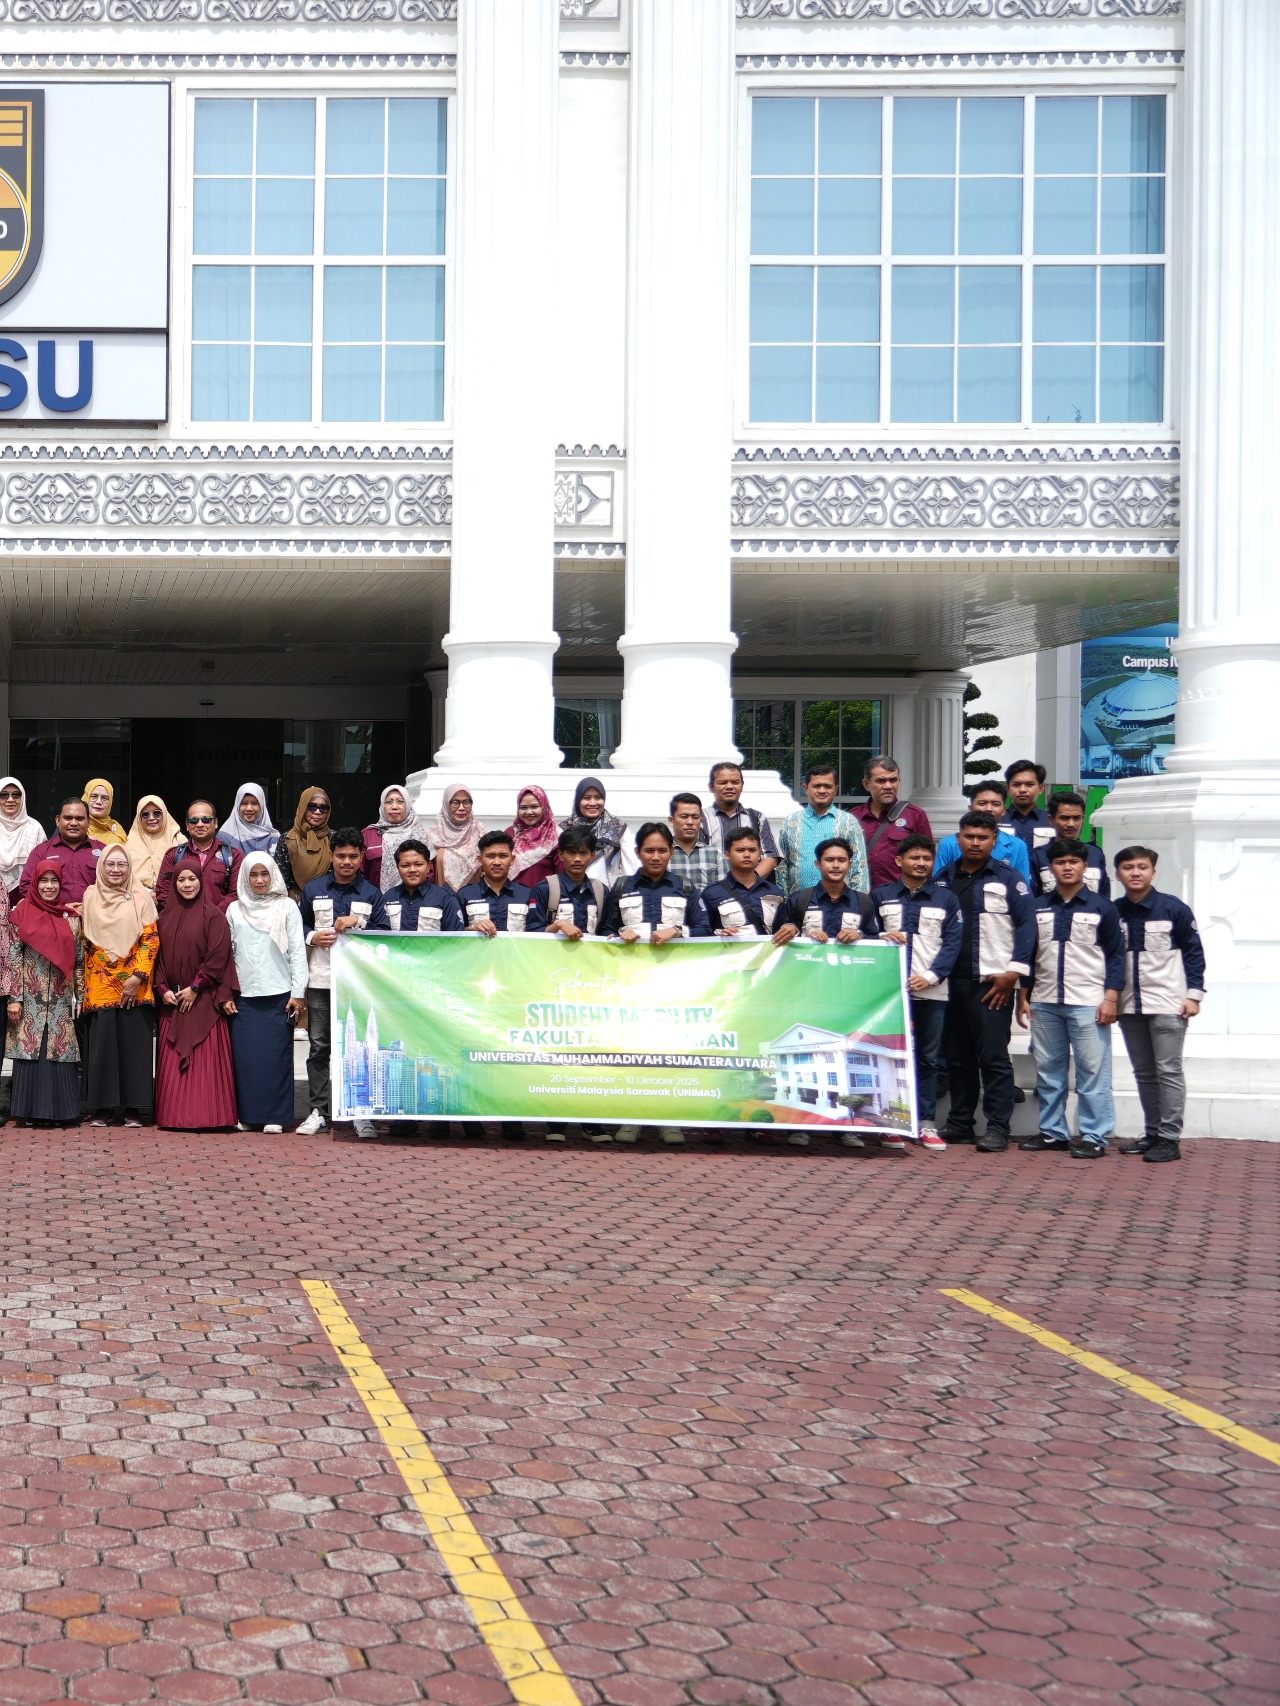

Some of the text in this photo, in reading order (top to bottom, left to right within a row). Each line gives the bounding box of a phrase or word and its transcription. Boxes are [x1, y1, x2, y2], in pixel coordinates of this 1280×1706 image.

[1122, 655, 1169, 670] Campus
[469, 1051, 777, 1069] UNIVERSITAS MUHAMMADIYAH SUMATERA UTARA
[550, 1074, 562, 1083] 20
[563, 1074, 616, 1085] September
[625, 1076, 634, 1084] 10
[636, 1076, 673, 1085] Oktober
[528, 1085, 721, 1099] Universiti Malaysia Sarawak (UNIMAS)
